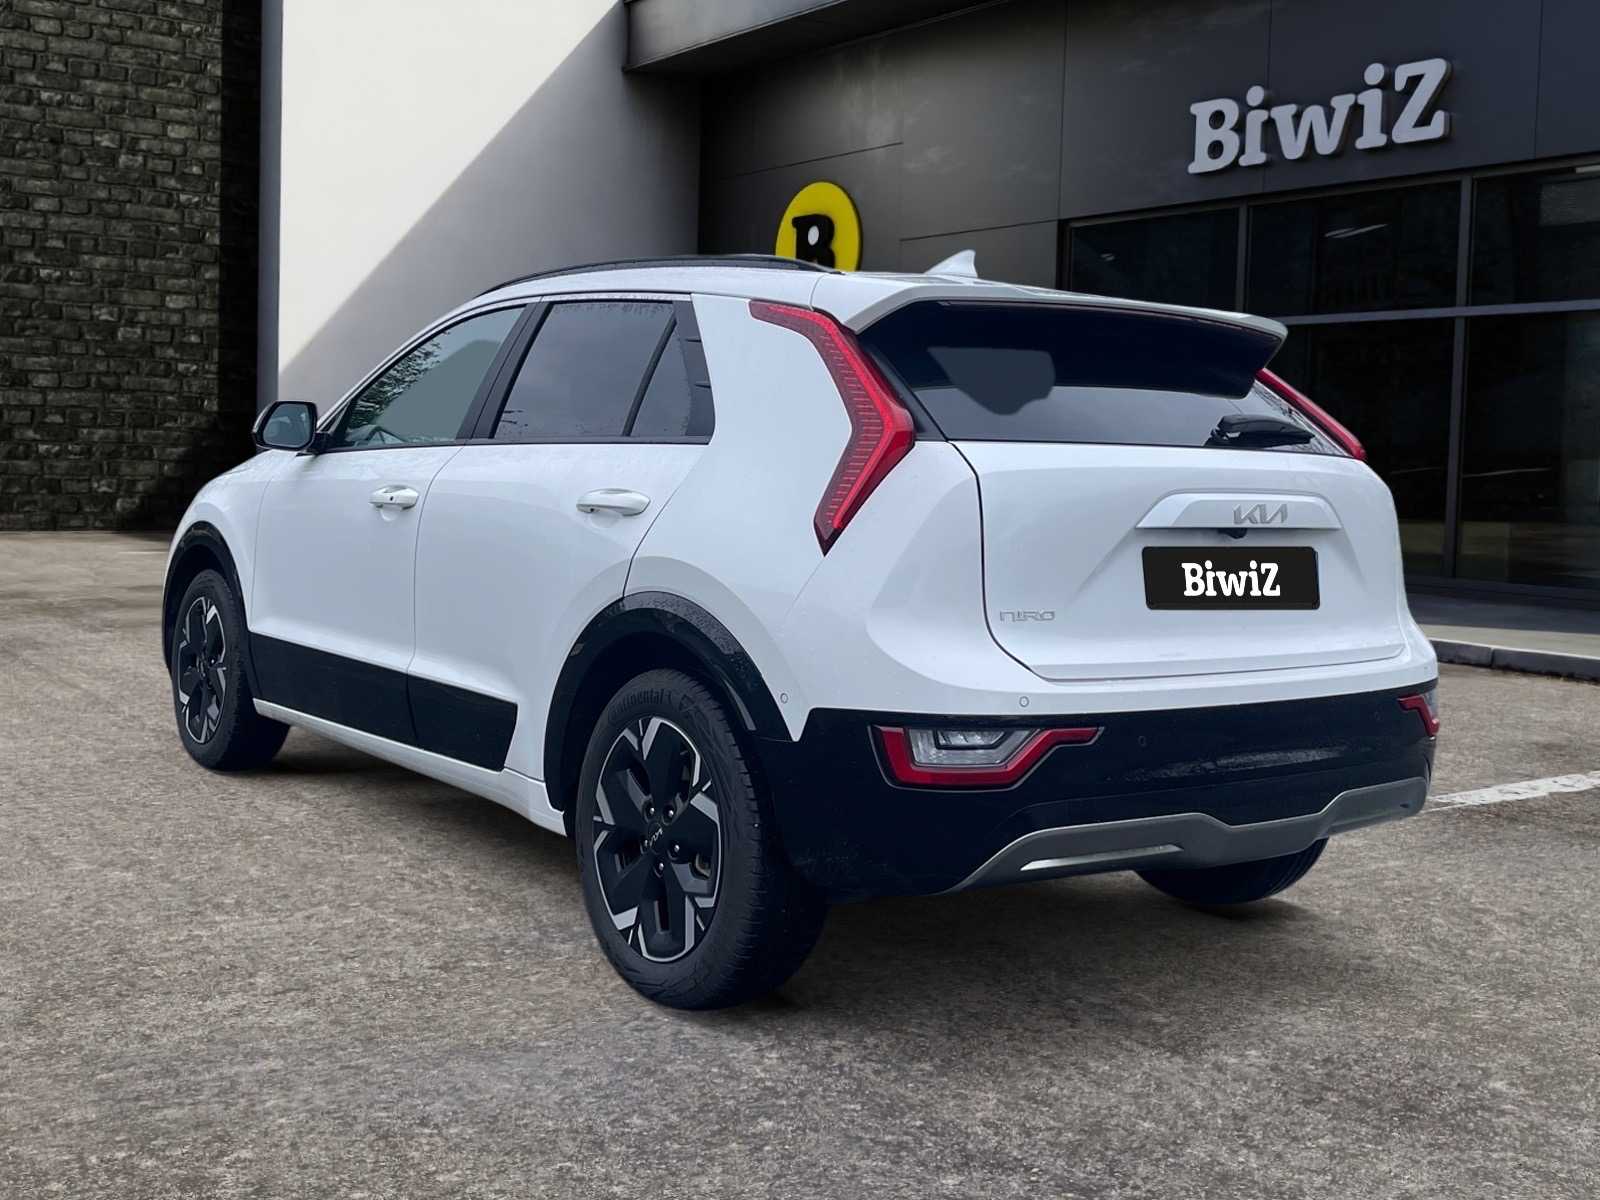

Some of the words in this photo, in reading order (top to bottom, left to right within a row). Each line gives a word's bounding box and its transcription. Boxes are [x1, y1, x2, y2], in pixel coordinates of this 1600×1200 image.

[1188, 57, 1449, 174] BiwiZ
[1233, 503, 1288, 524] KIA
[1181, 560, 1280, 597] BiwiZ
